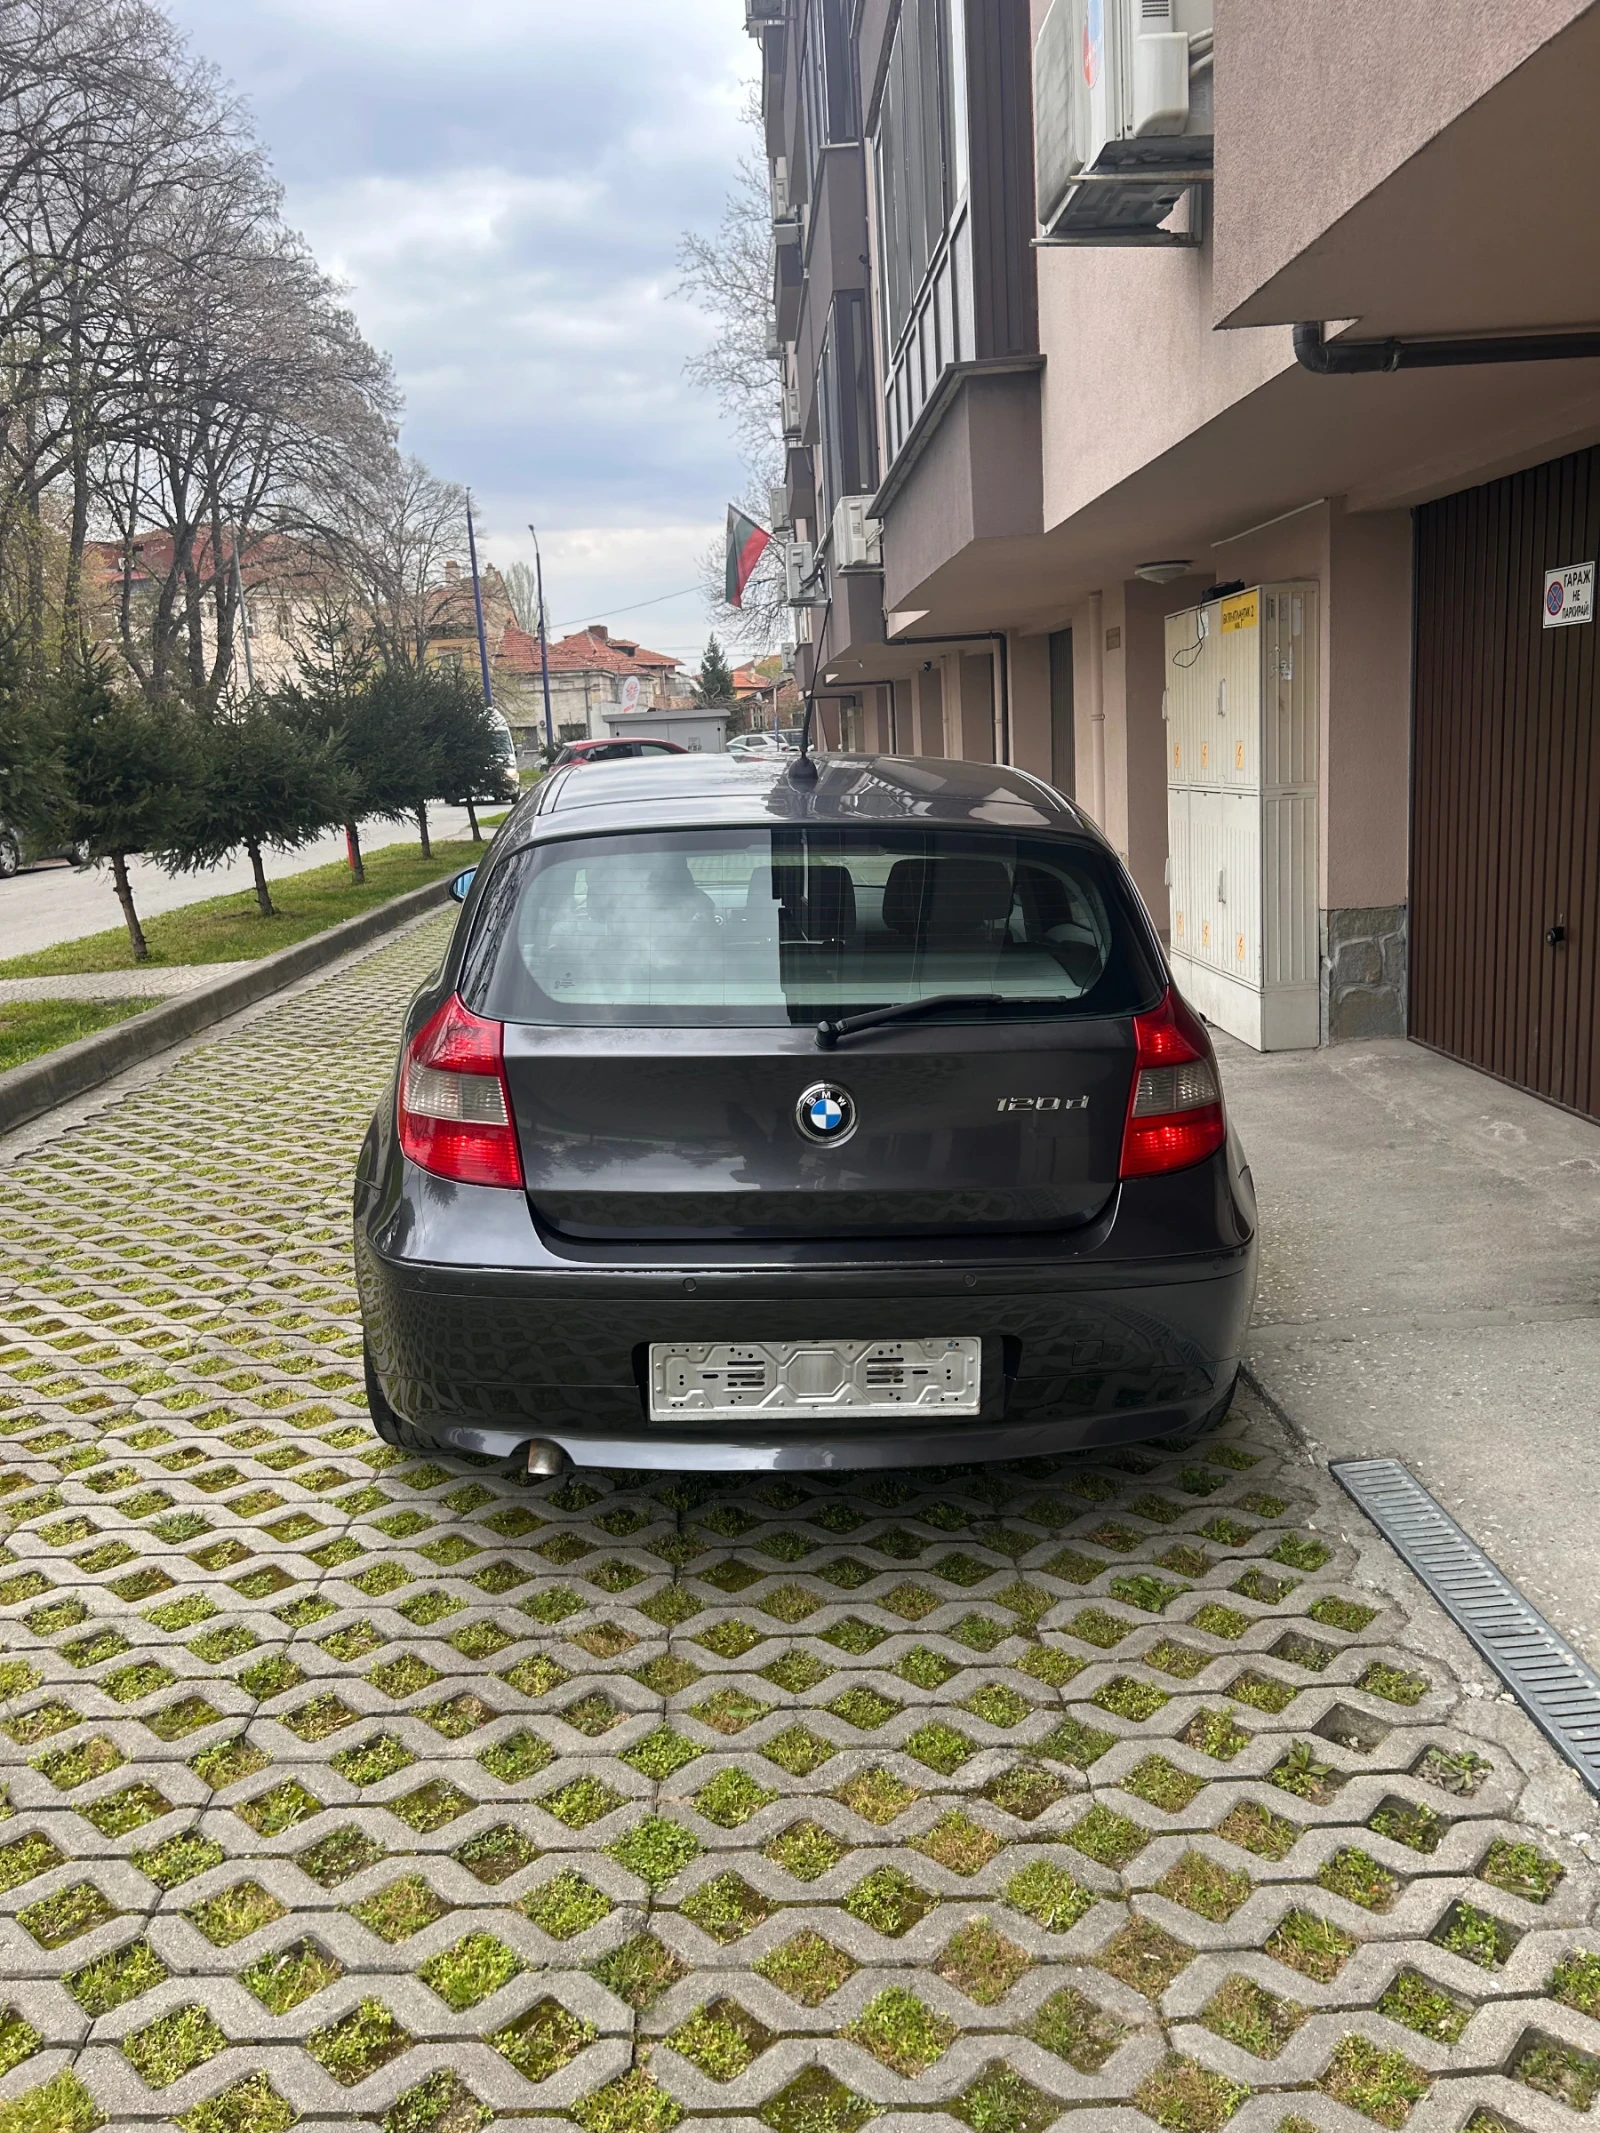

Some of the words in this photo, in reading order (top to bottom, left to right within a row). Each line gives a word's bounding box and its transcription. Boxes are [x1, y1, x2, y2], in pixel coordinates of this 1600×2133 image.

[1564, 569, 1591, 587] ГАРАЖ
[1572, 589, 1581, 602] НЕ
[806, 1090, 847, 1107] BMW
[996, 1095, 1090, 1112] 120d
